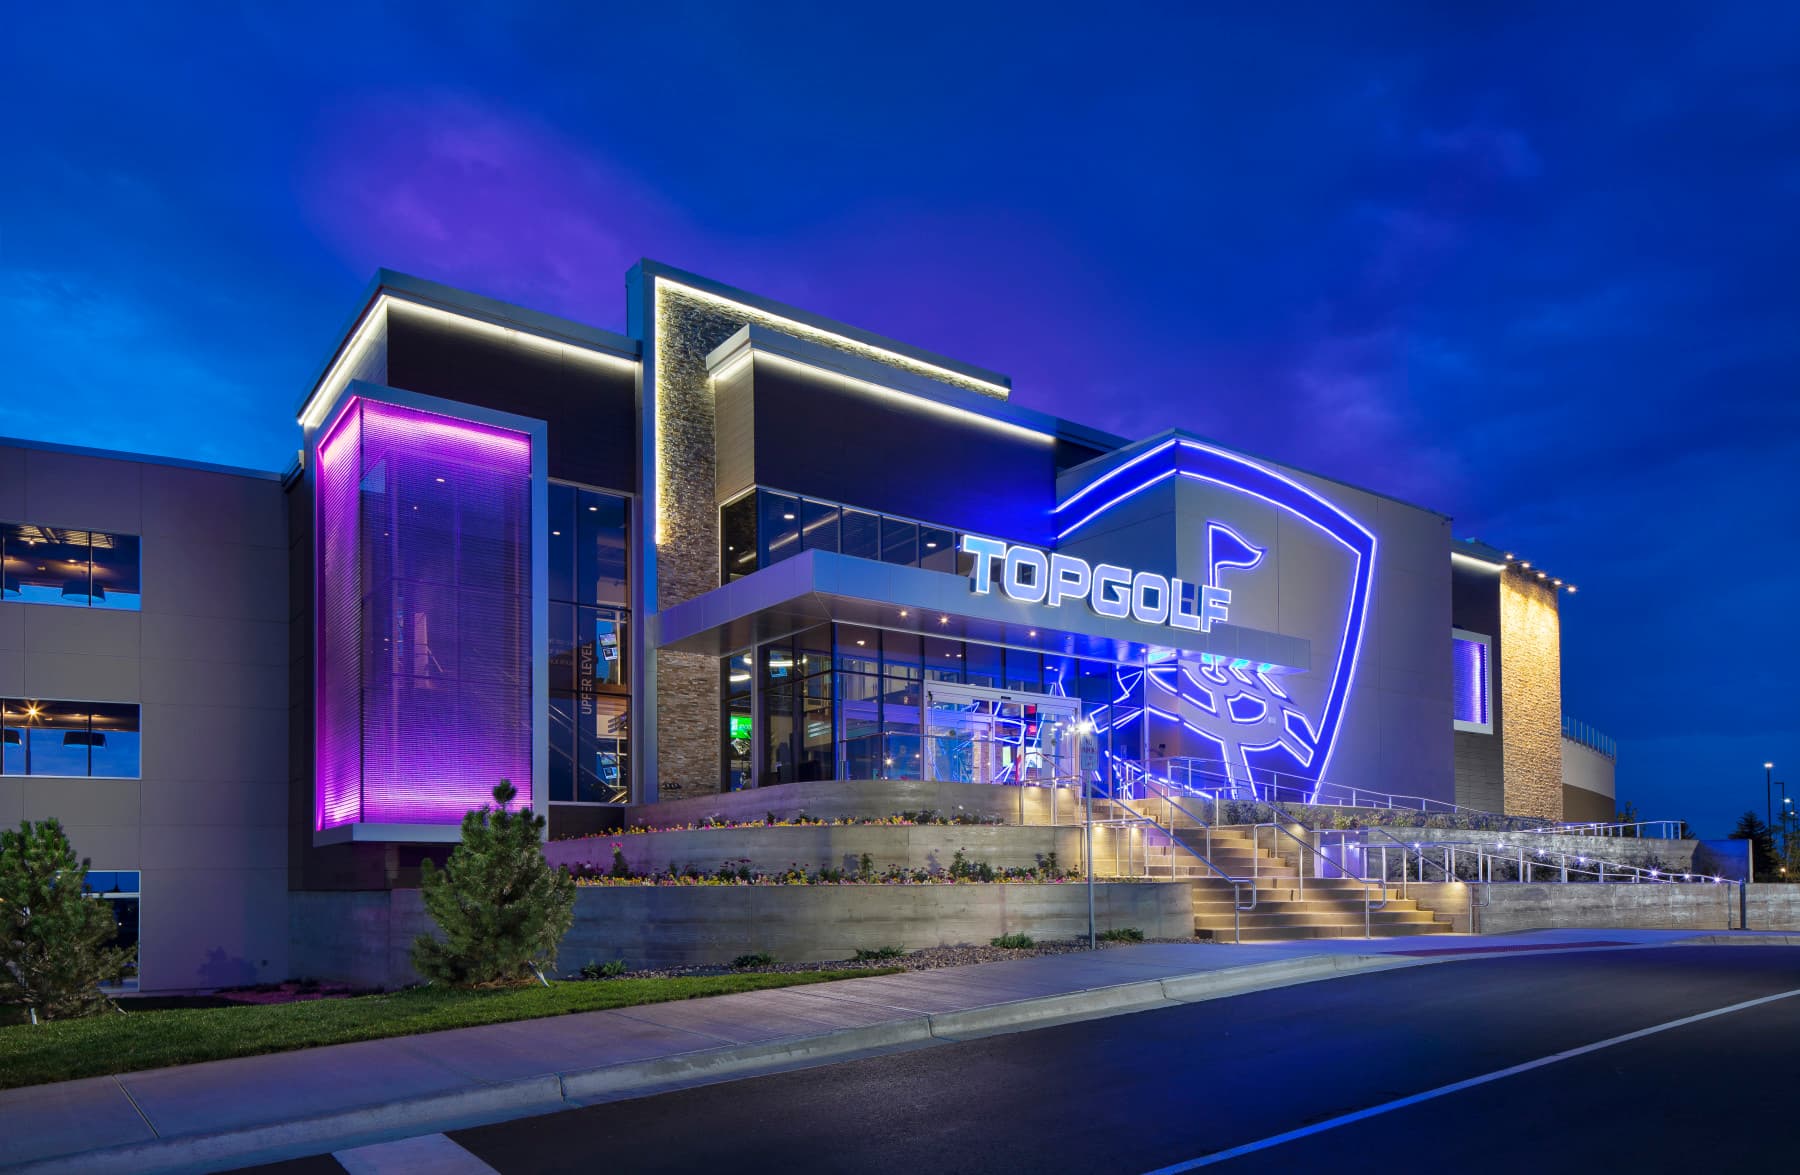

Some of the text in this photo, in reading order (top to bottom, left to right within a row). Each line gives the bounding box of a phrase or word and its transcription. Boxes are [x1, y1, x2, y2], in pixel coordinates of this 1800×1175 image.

[962, 534, 1232, 633] TOPGOLF
[581, 643, 593, 715] UPPER LEVEL
